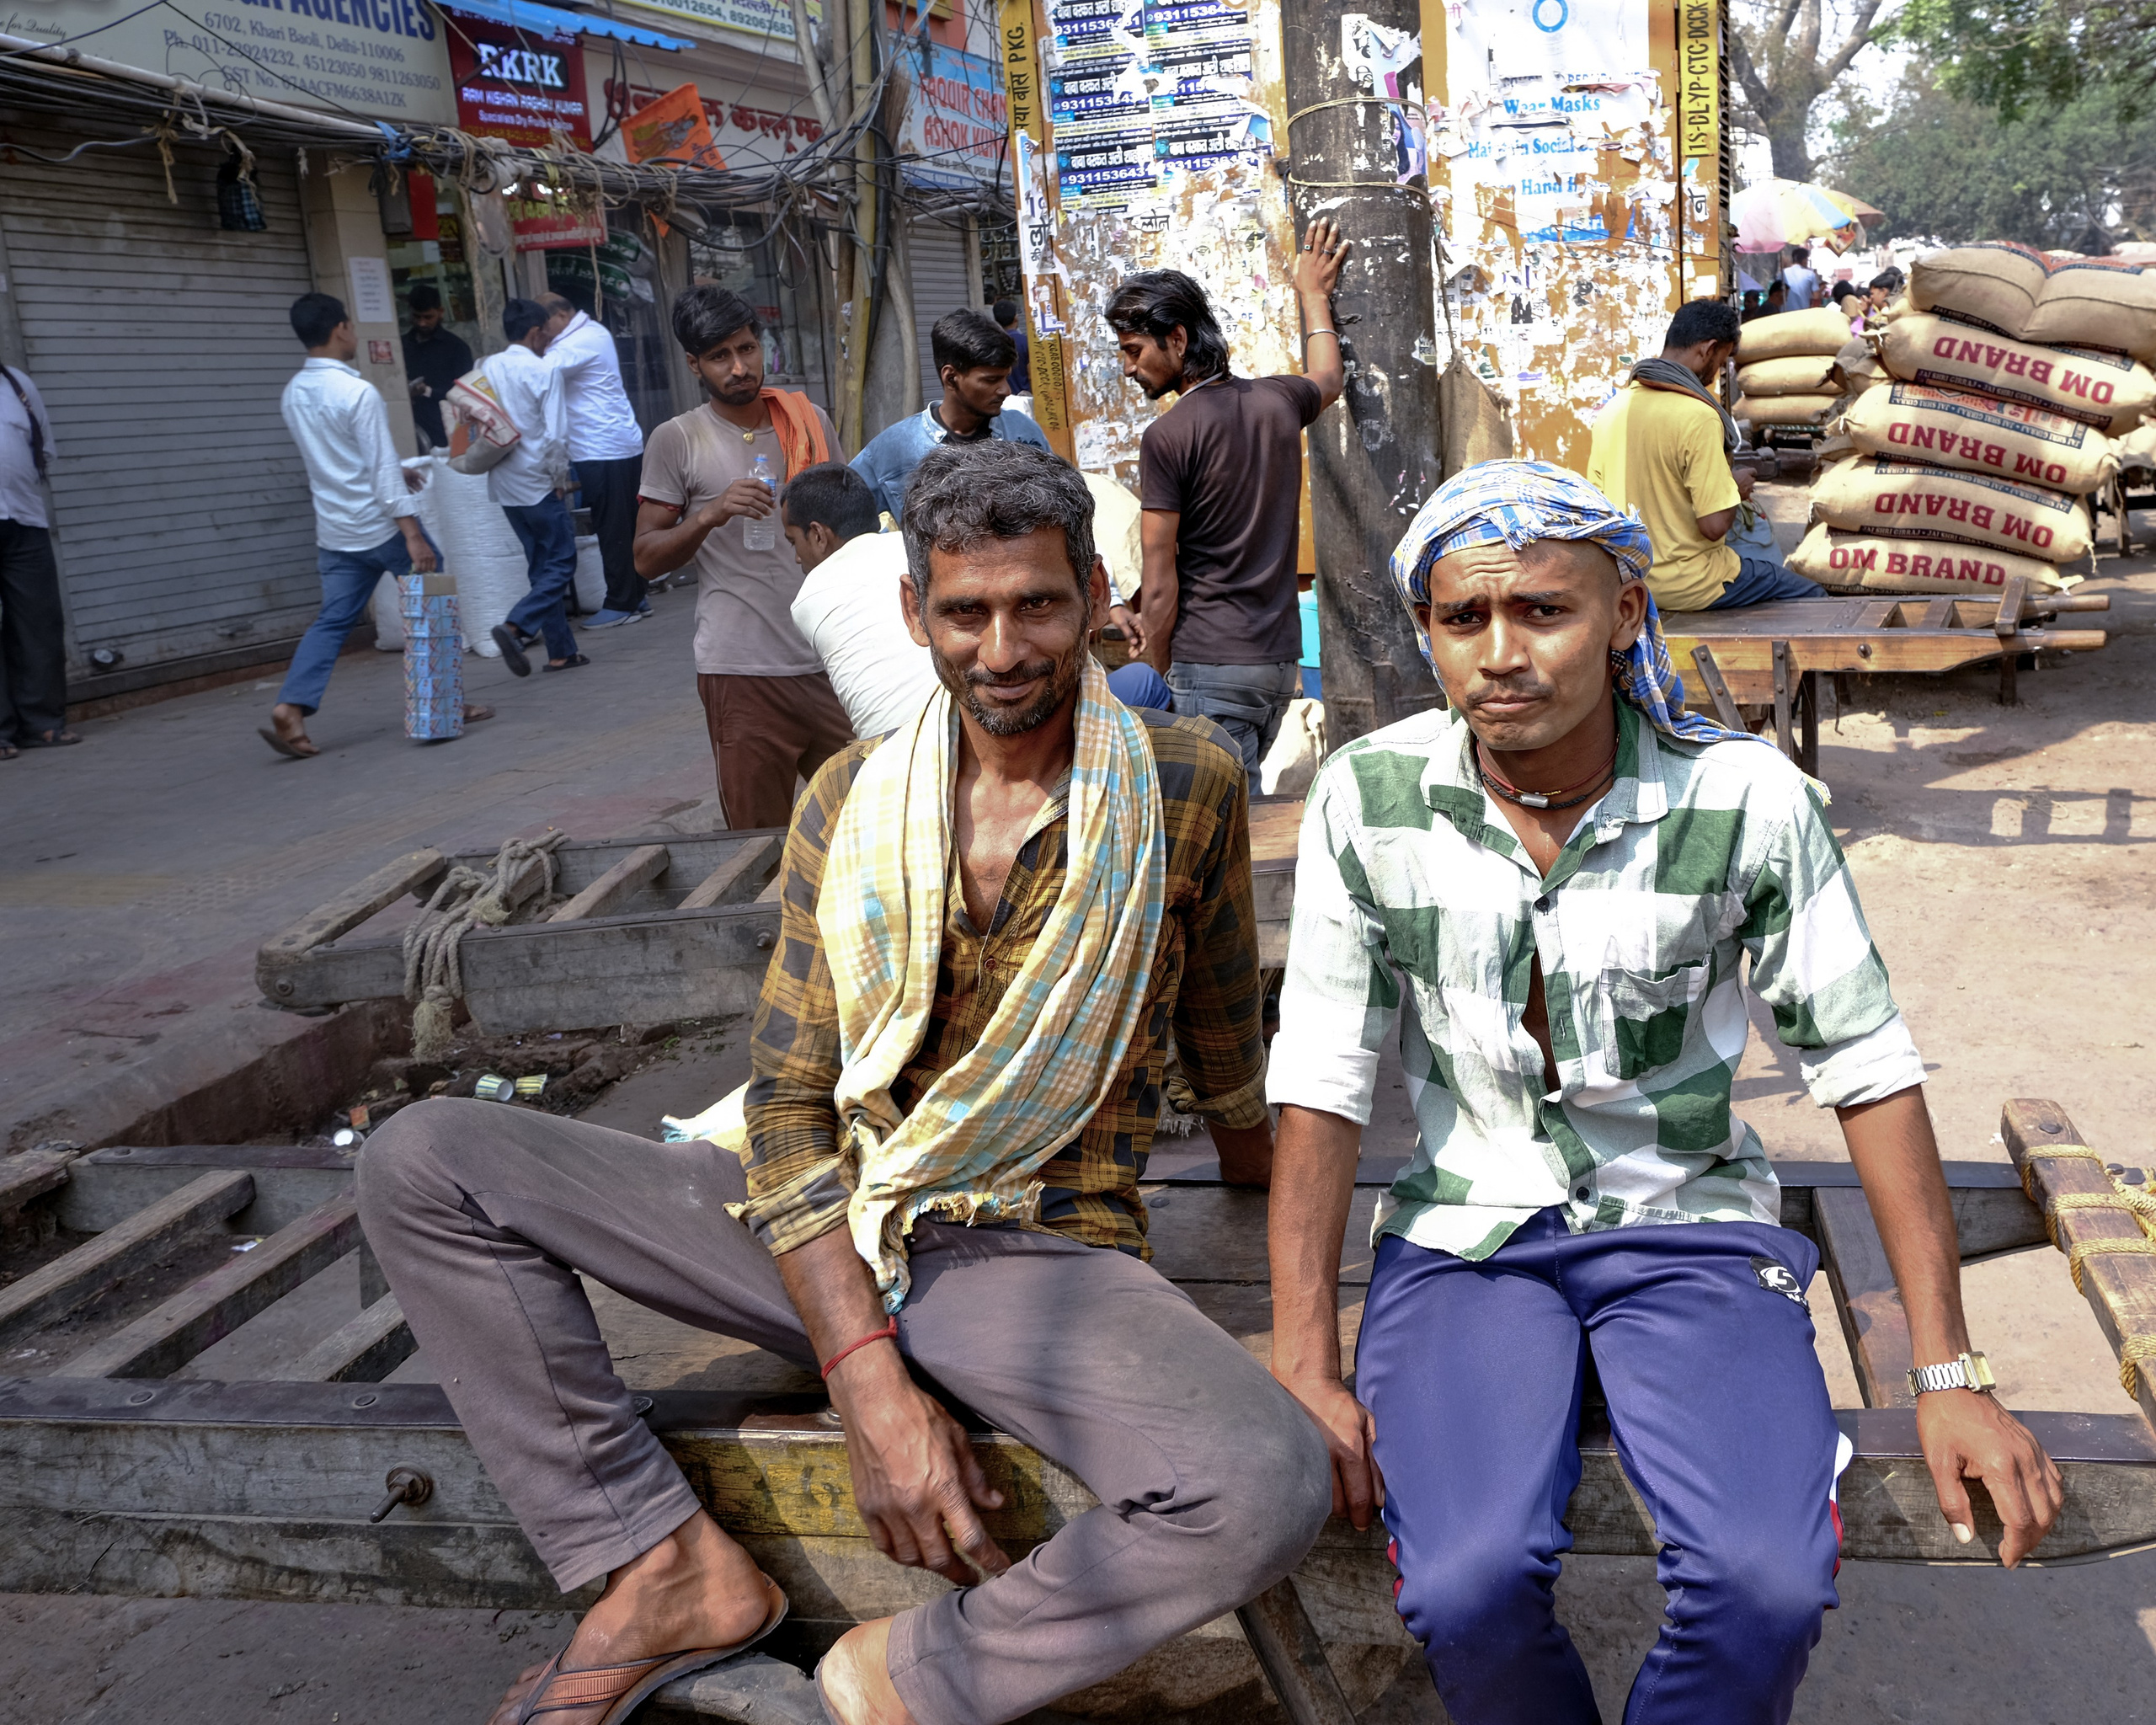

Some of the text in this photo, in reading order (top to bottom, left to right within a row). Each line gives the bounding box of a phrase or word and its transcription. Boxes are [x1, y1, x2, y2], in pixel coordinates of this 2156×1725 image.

[24, 19, 67, 44] Quality
[205, 11, 405, 63] 6702, Khari Baoli, Delhi-110006
[728, 9, 796, 36] 892063683
[974, 86, 1009, 125] CHAN
[1550, 94, 1601, 113] Masks
[923, 115, 969, 153] ASHOK
[1533, 136, 1575, 155] Social
[1933, 336, 2055, 386] BRAND
[2057, 369, 2116, 405] OM
[1887, 422, 2068, 484] OM BRAND
[1874, 493, 2055, 549] OM BRAND
[1829, 547, 2006, 586] OM BRAND
